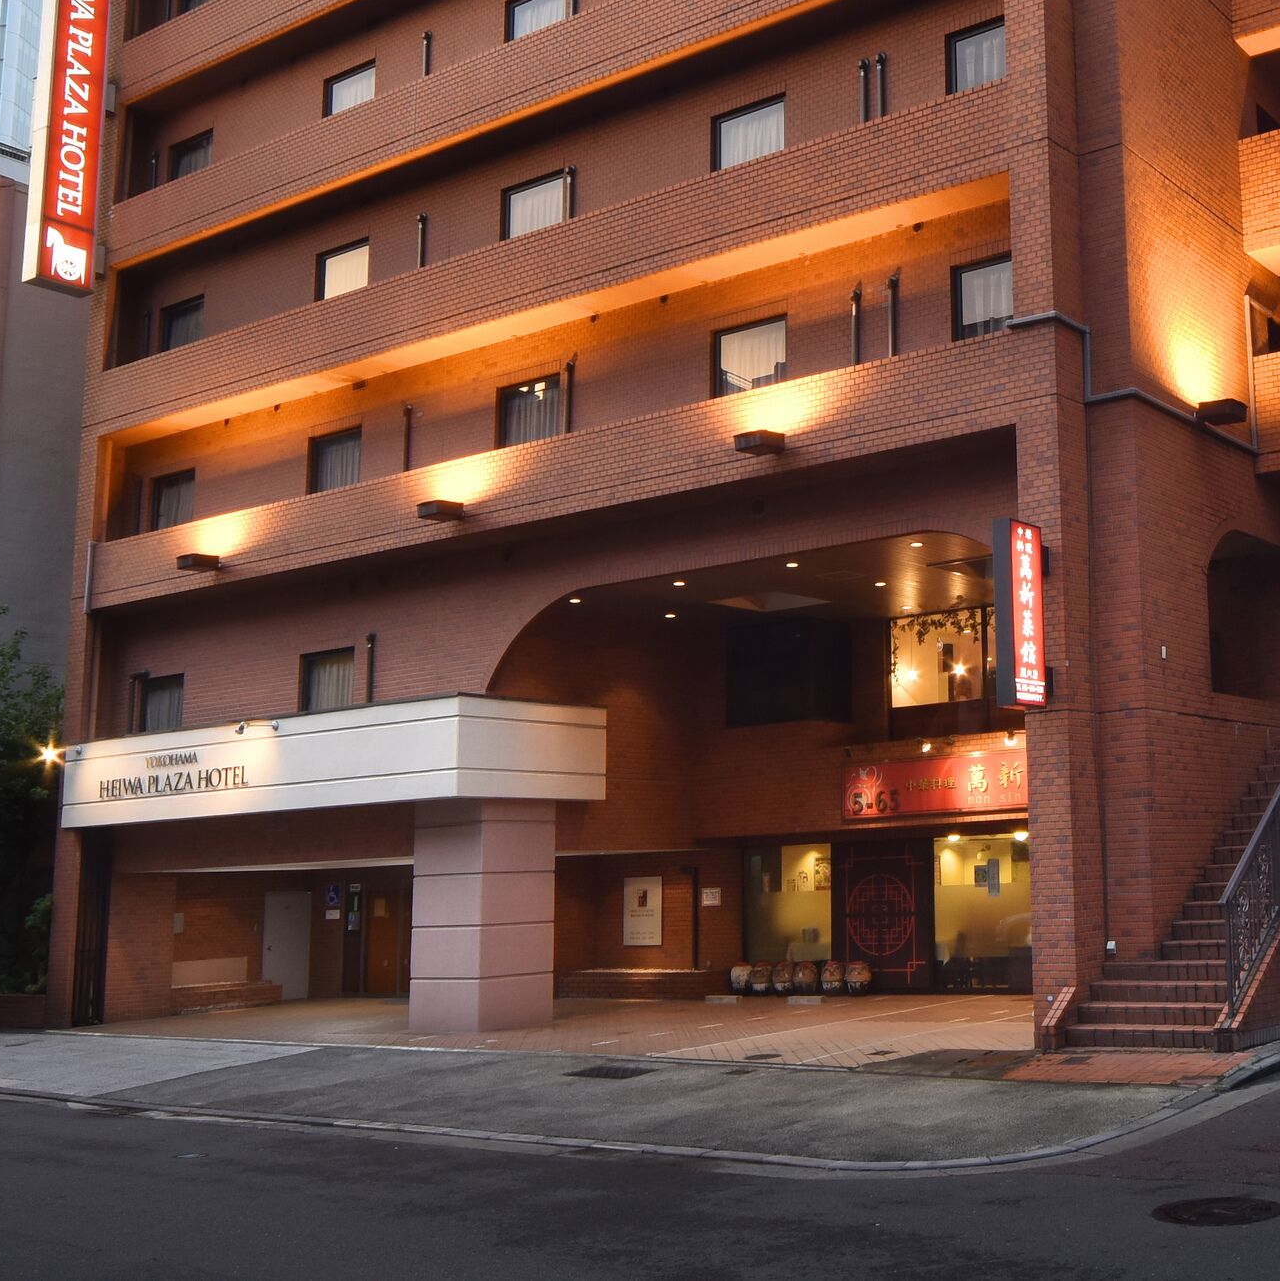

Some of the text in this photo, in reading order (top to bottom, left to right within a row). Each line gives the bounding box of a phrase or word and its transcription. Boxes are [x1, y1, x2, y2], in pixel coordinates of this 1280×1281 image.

[63, 24, 95, 116] PLAZA
[56, 120, 88, 216] HOTEL
[99, 765, 249, 799] HEIWA PLAZA HOTEL
[144, 751, 198, 769] YOKOHAMA
